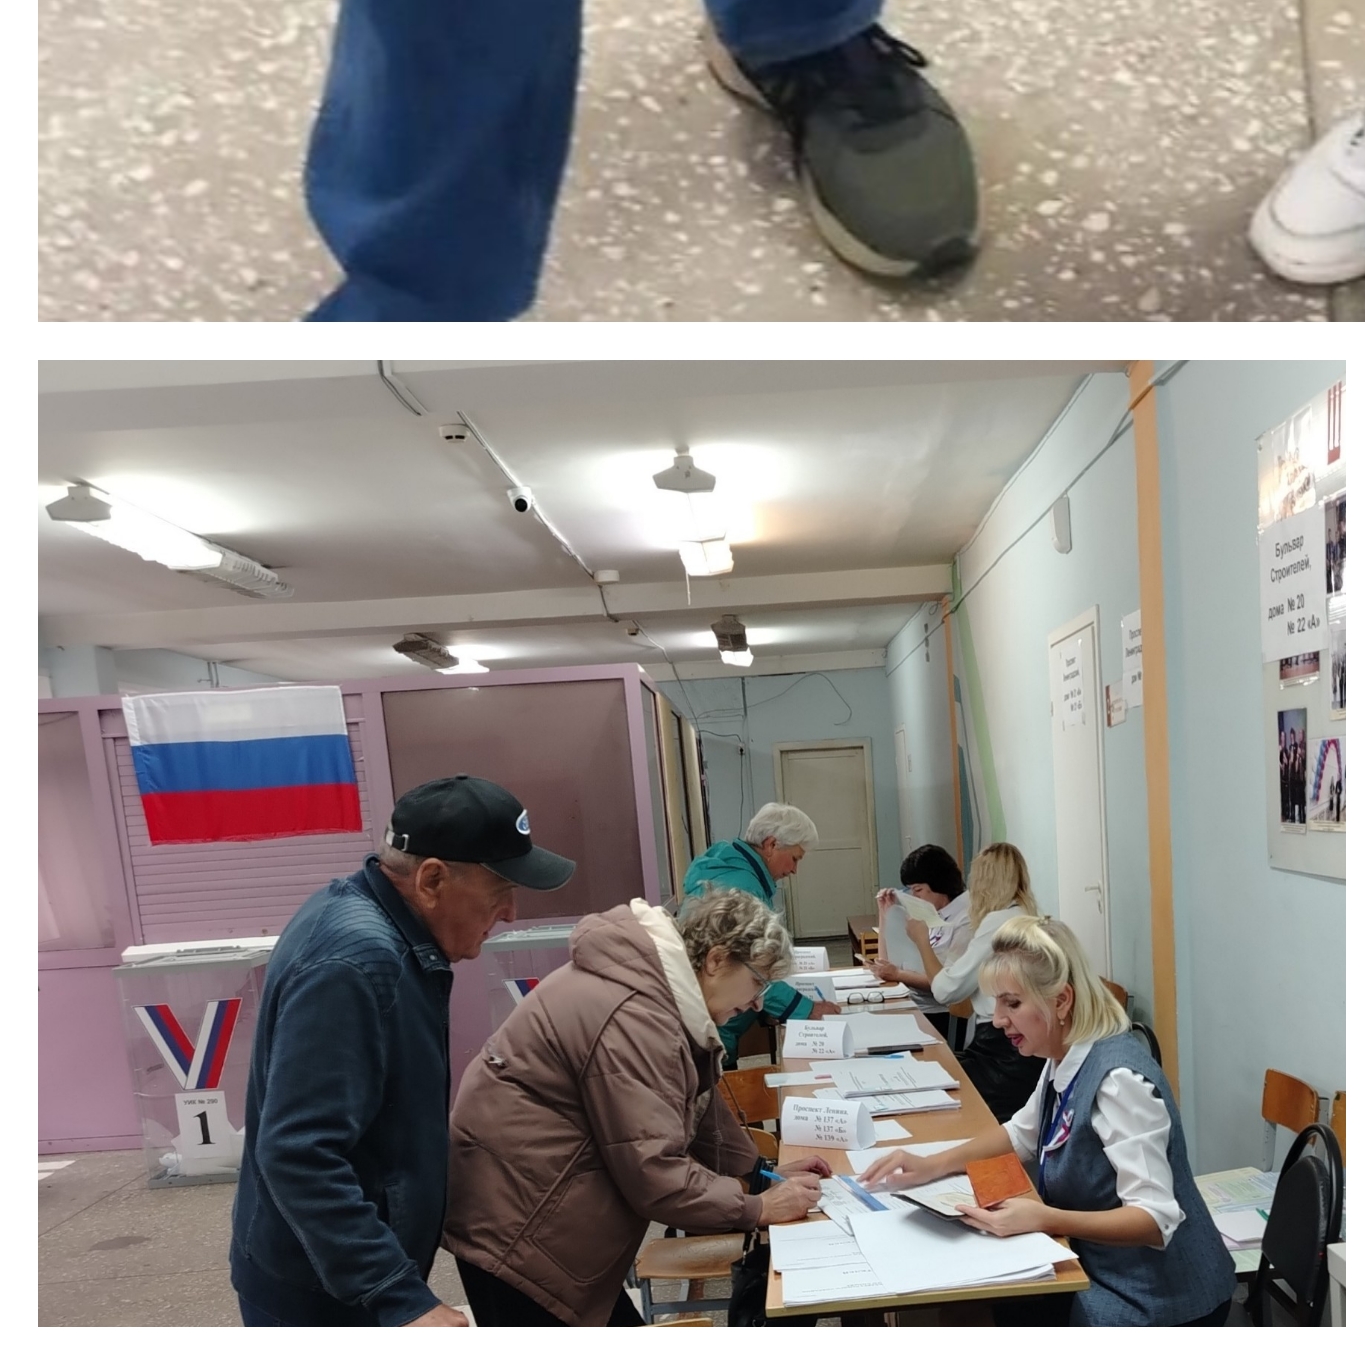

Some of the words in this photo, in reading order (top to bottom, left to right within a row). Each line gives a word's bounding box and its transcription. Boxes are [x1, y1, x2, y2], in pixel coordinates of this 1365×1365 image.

[1275, 535, 1304, 559] Бульвар
[1270, 554, 1311, 583] Строителей,
[1268, 603, 1284, 621] дома
[1287, 597, 1295, 612] №
[1297, 594, 1304, 610] 20
[1287, 620, 1295, 635] №
[1297, 617, 1305, 633] 22
[1307, 614, 1320, 630] «А»
[793, 1104, 822, 1114] Проспект
[823, 1107, 848, 1115] Ленина,
[193, 1111, 216, 1145] 1
